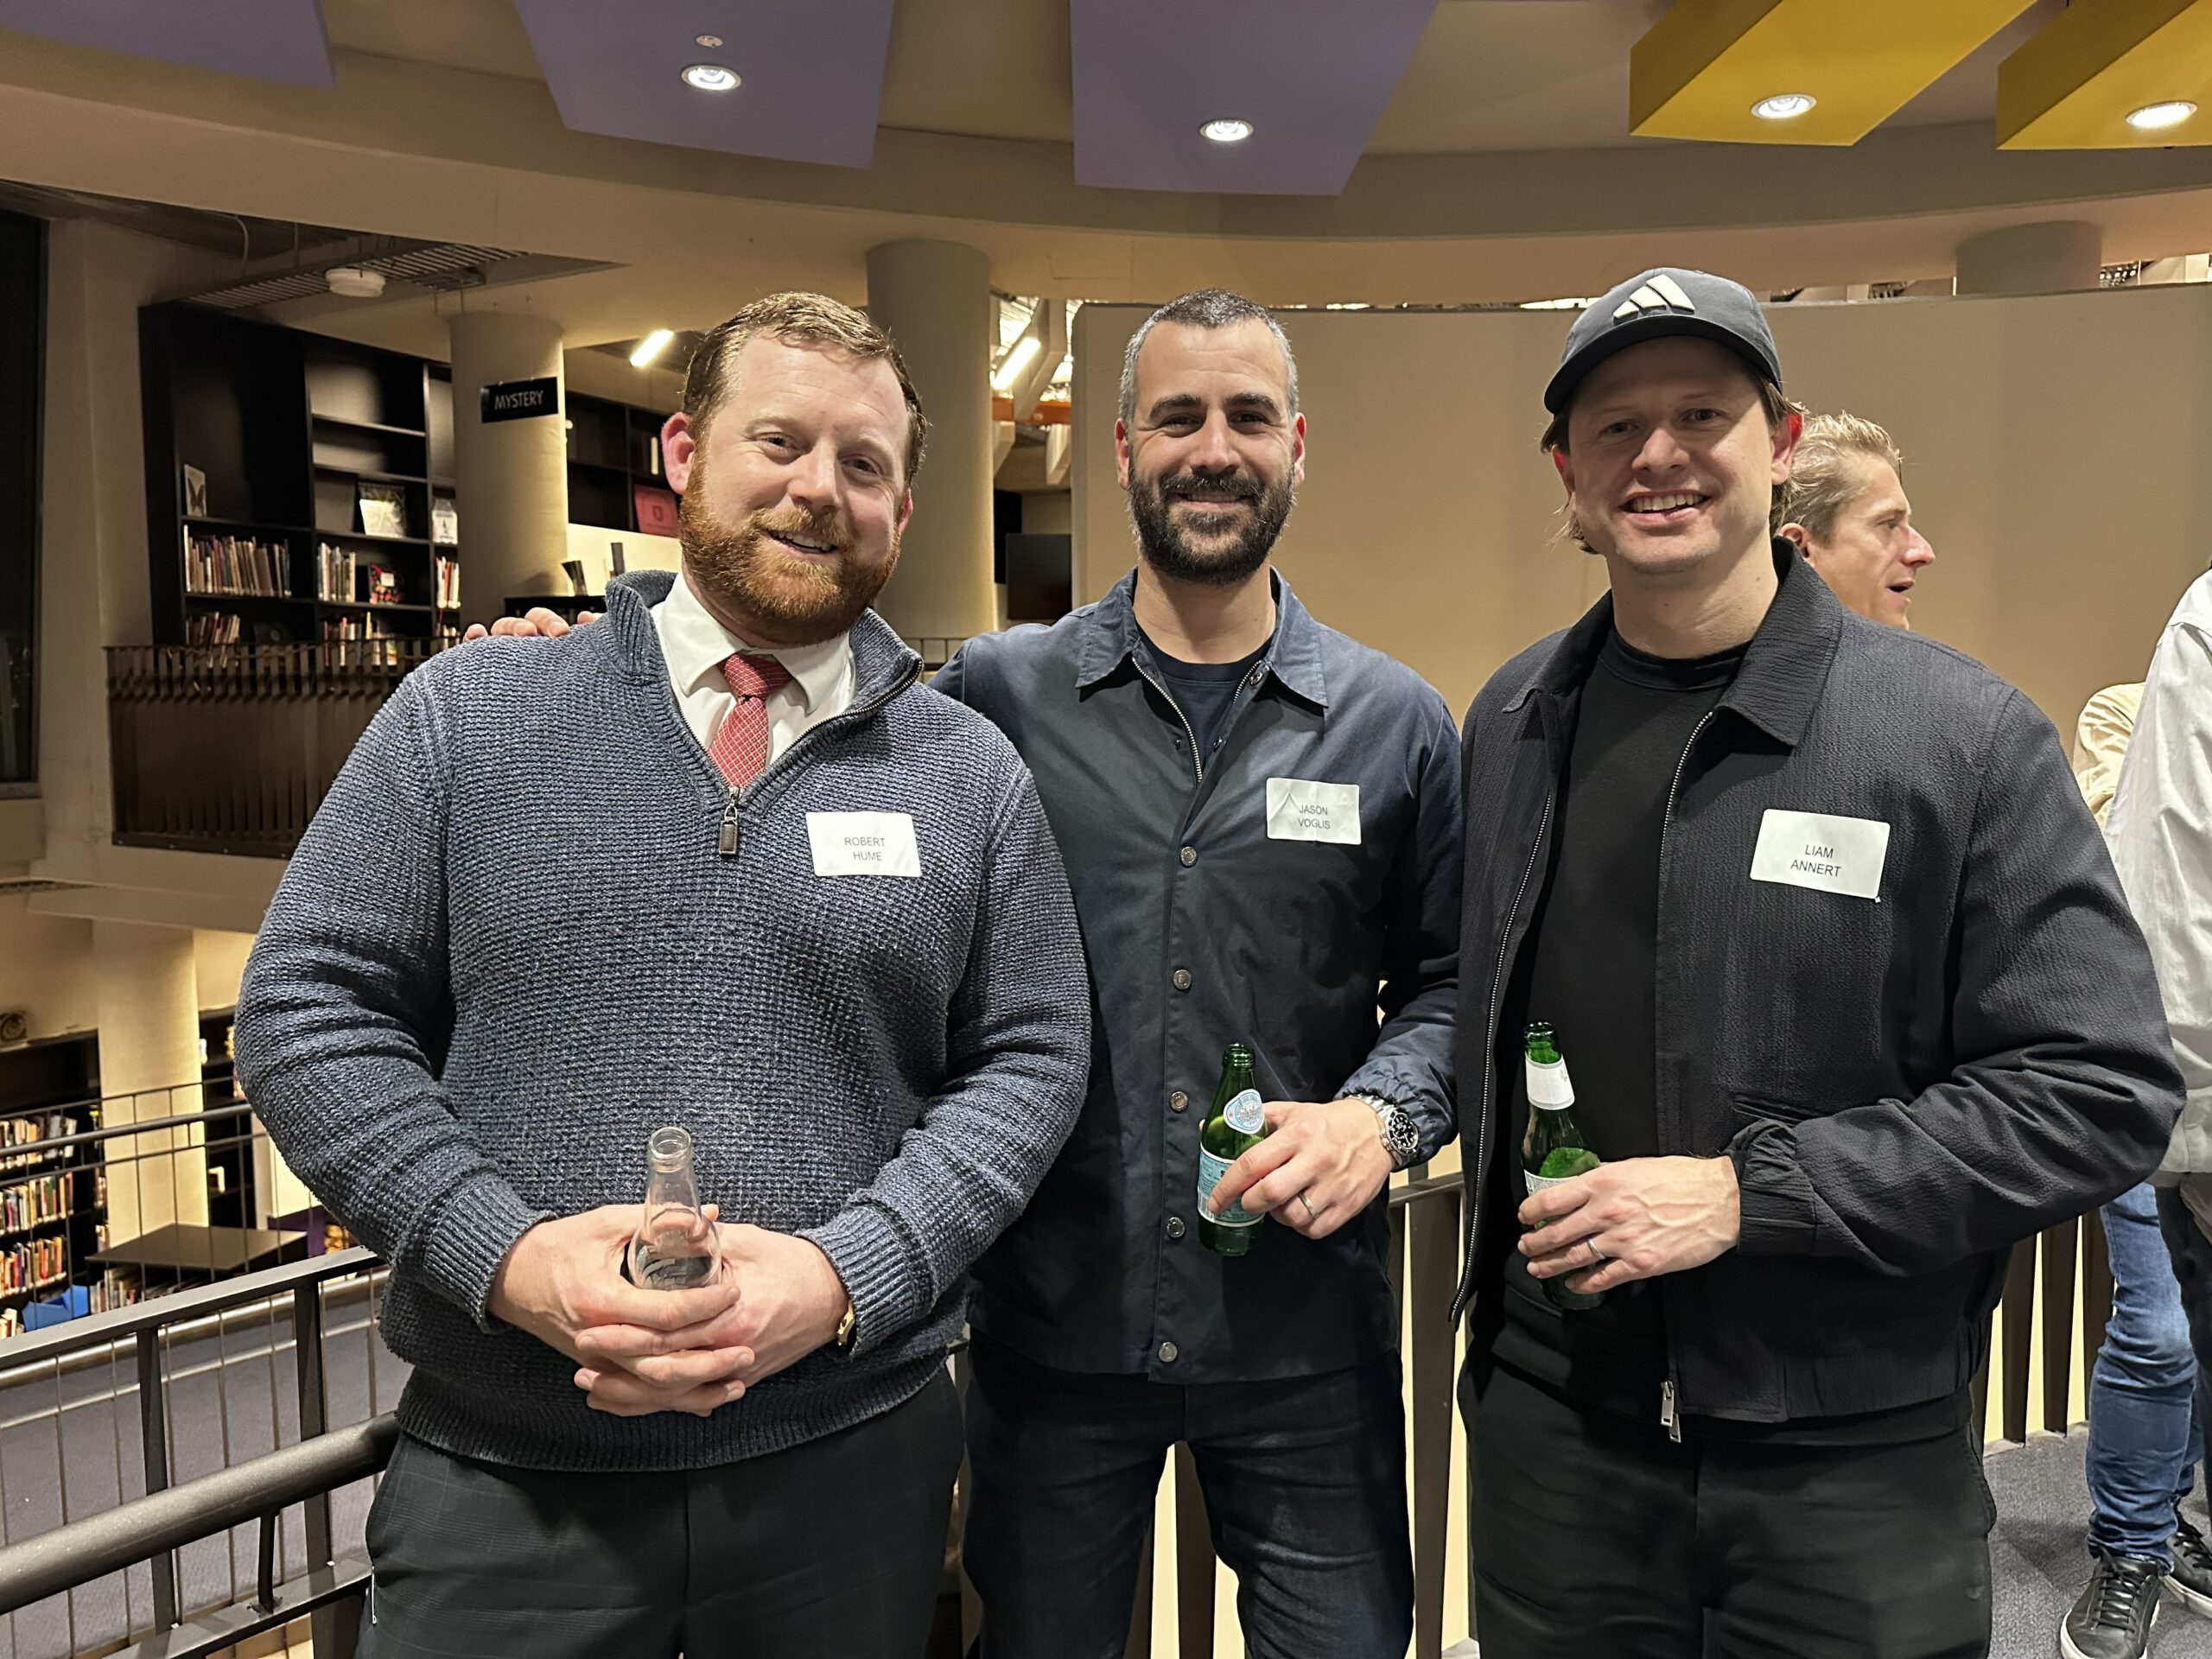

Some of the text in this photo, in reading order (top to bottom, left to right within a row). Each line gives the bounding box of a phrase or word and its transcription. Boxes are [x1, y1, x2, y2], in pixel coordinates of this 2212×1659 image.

[494, 390, 543, 410] MYSTERY
[1299, 804, 1328, 816] JASON
[1298, 818, 1331, 830] VOGLIS
[844, 836, 886, 848] ROBERT
[853, 851, 883, 861] HUME
[1805, 844, 1834, 859] LIAM
[1790, 859, 1841, 877] ANNERT
